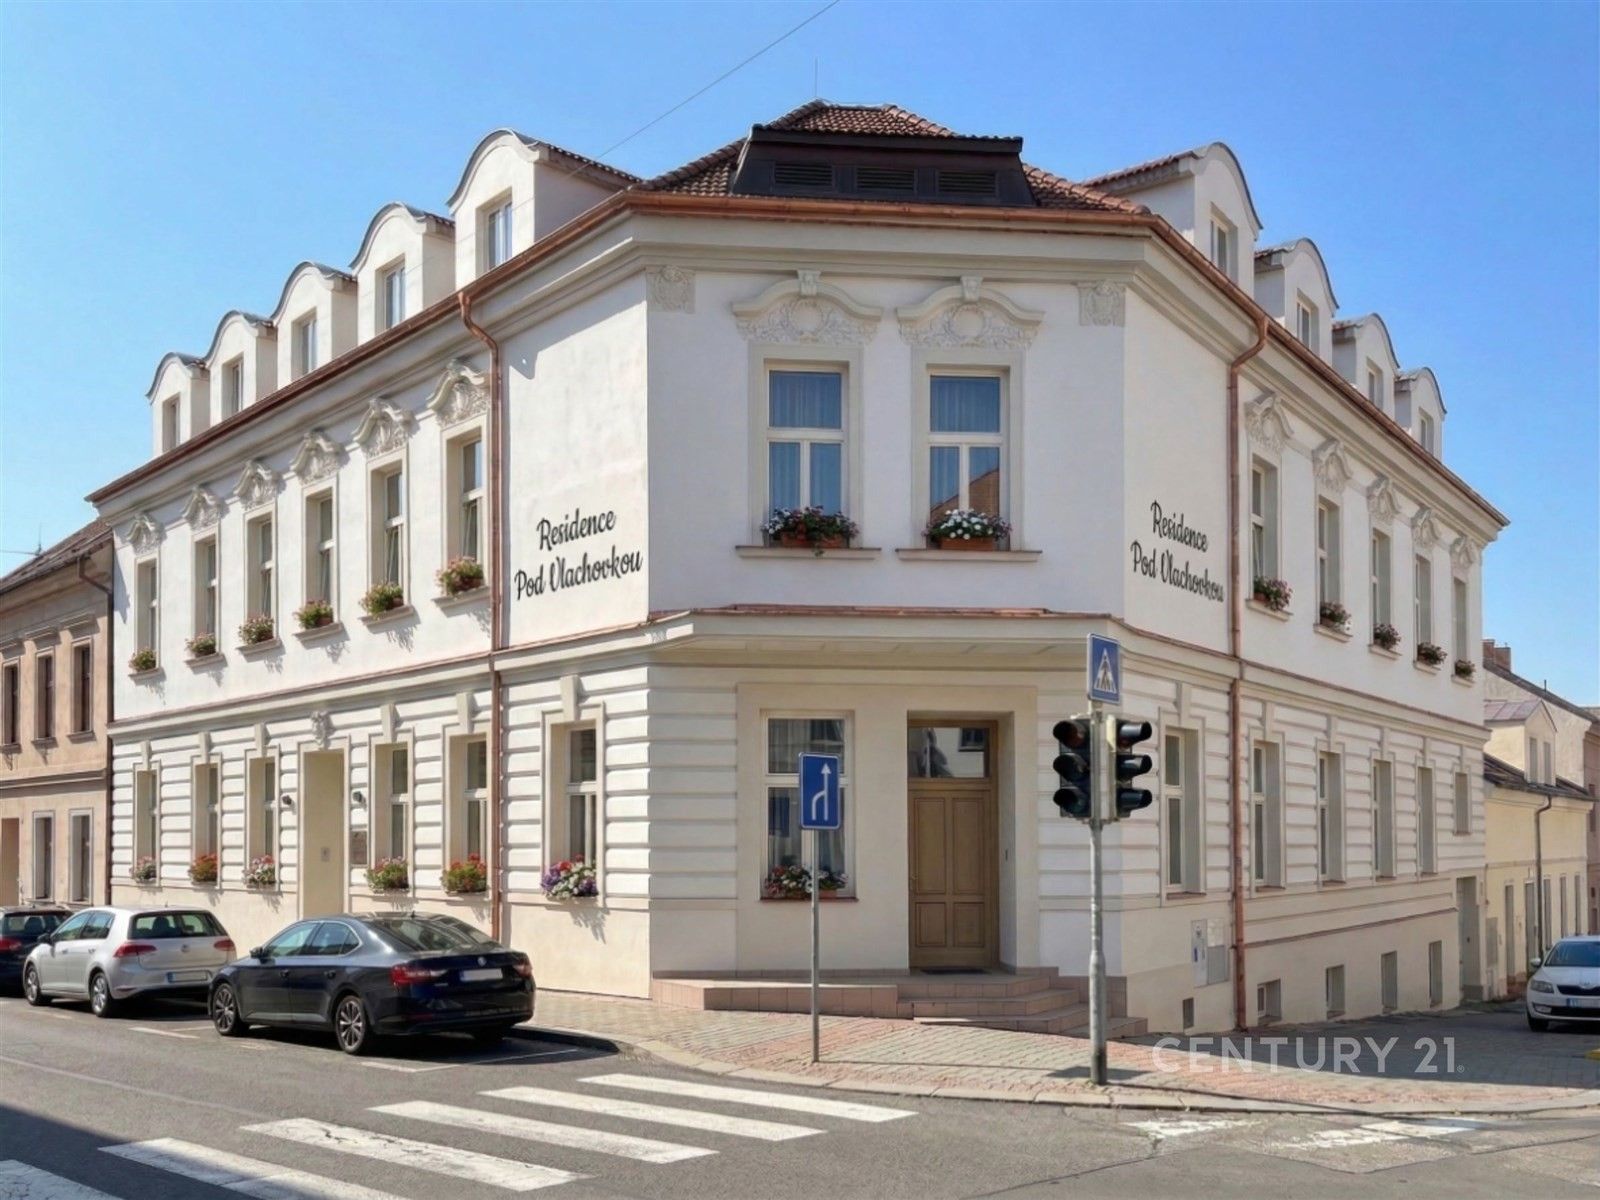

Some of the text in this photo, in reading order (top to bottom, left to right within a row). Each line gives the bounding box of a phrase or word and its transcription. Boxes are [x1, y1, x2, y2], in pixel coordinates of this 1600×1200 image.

[536, 507, 616, 551] Residence
[1150, 499, 1208, 553] Residence
[514, 544, 643, 601] Pod Vlachovkou
[1130, 540, 1225, 603] Pod Vlachovkou
